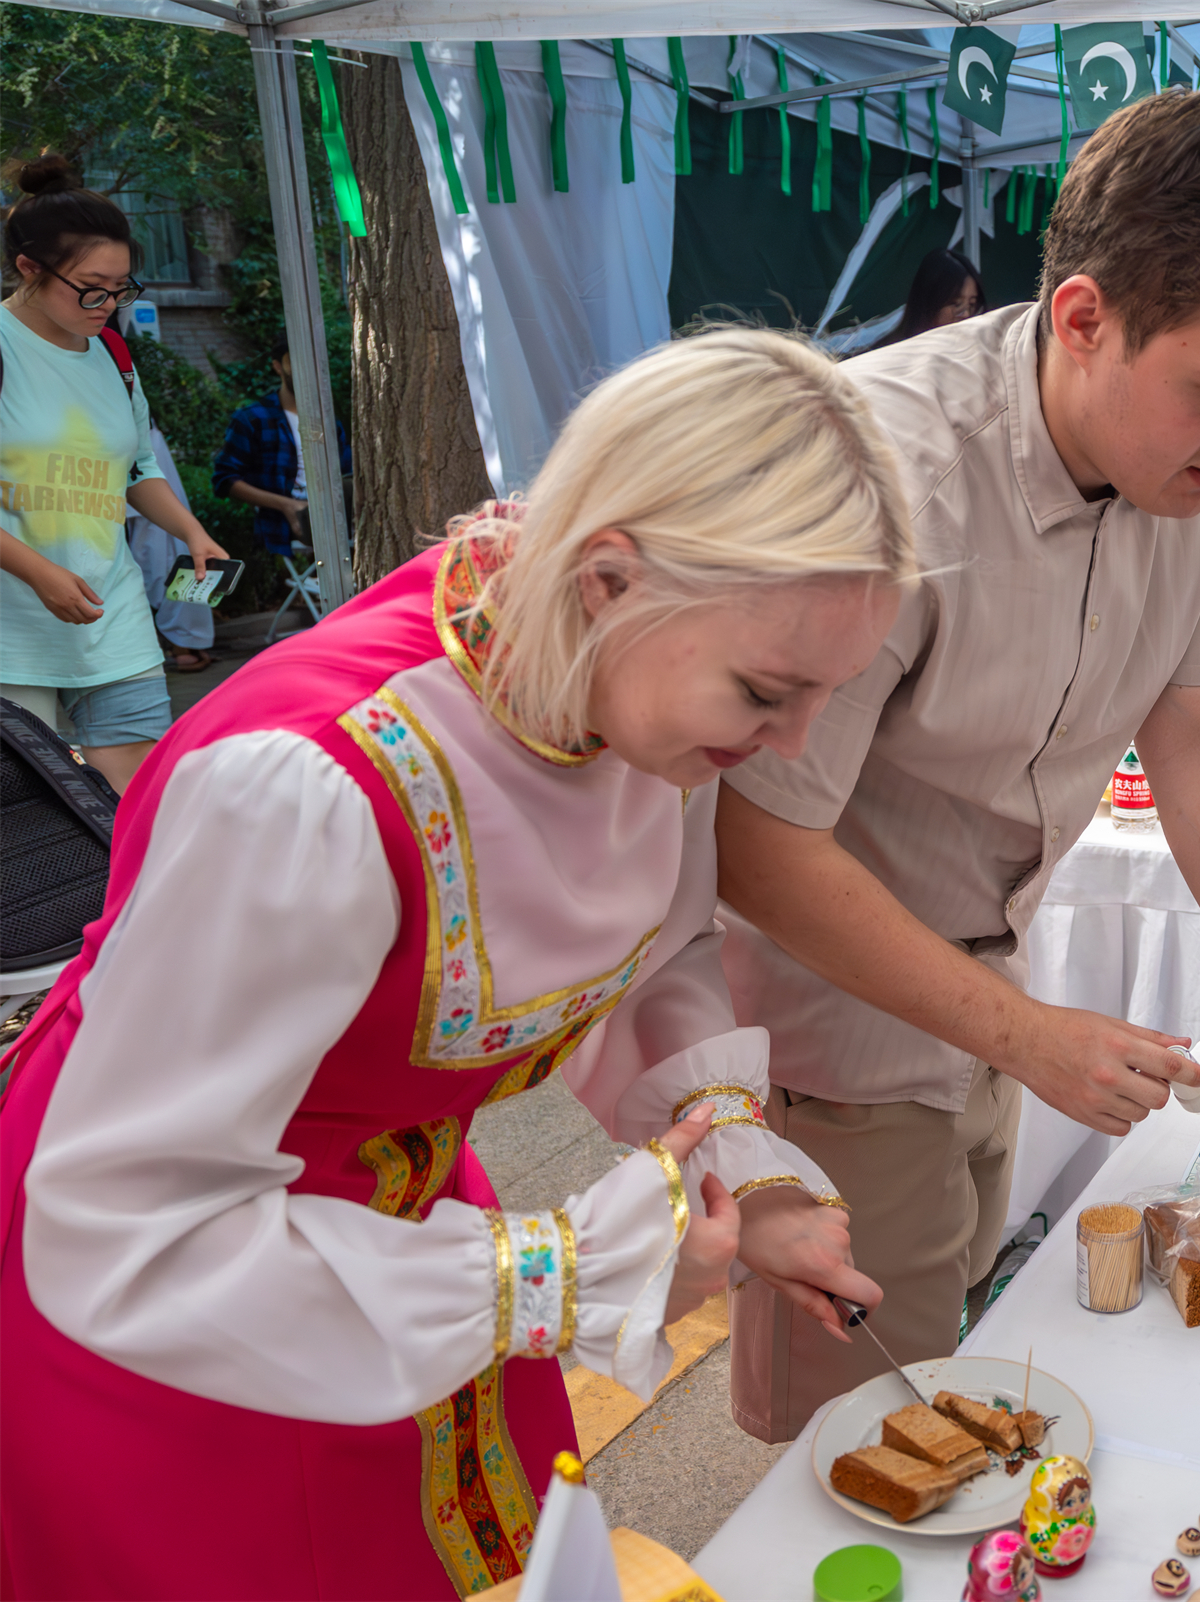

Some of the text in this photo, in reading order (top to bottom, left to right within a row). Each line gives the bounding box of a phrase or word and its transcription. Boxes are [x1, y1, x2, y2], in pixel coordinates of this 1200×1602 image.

[46, 452, 110, 490] FASH
[30, 747, 76, 775] NIKE
[61, 780, 105, 808] NIKE
